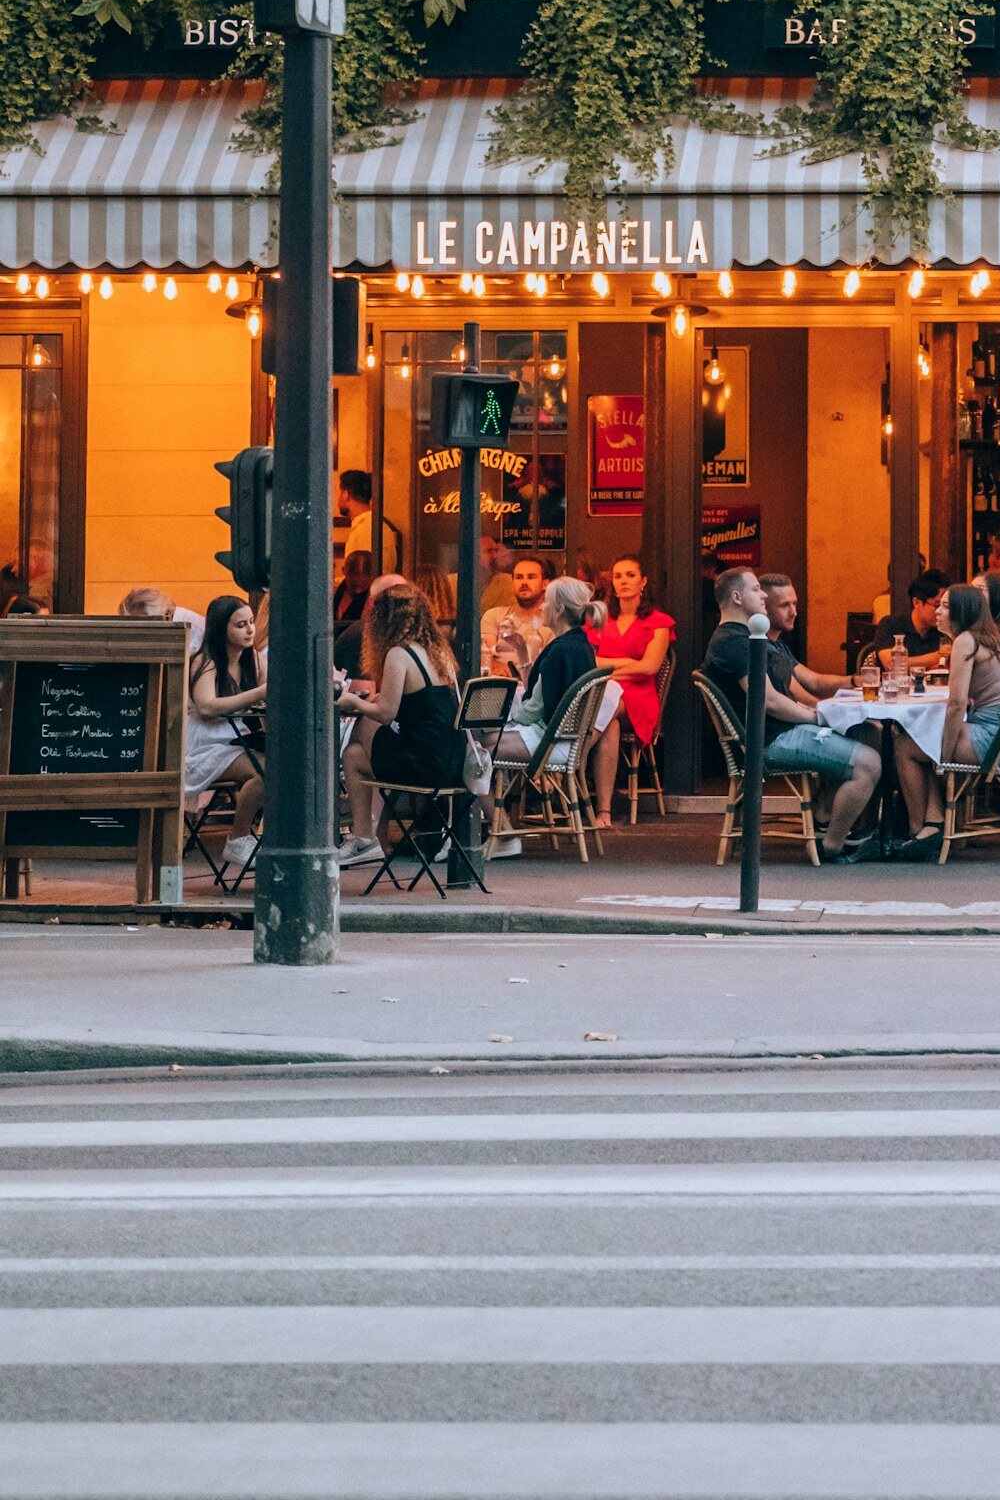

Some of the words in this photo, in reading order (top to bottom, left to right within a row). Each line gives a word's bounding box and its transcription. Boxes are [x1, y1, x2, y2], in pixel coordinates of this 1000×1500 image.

[416, 221, 457, 265] LE
[475, 220, 708, 265] CAMPANELLA
[596, 410, 645, 429] STELLA
[597, 457, 645, 472] ARTOIS
[41, 678, 84, 701] Negroni
[40, 702, 63, 717] Tom
[40, 746, 61, 758] Old
